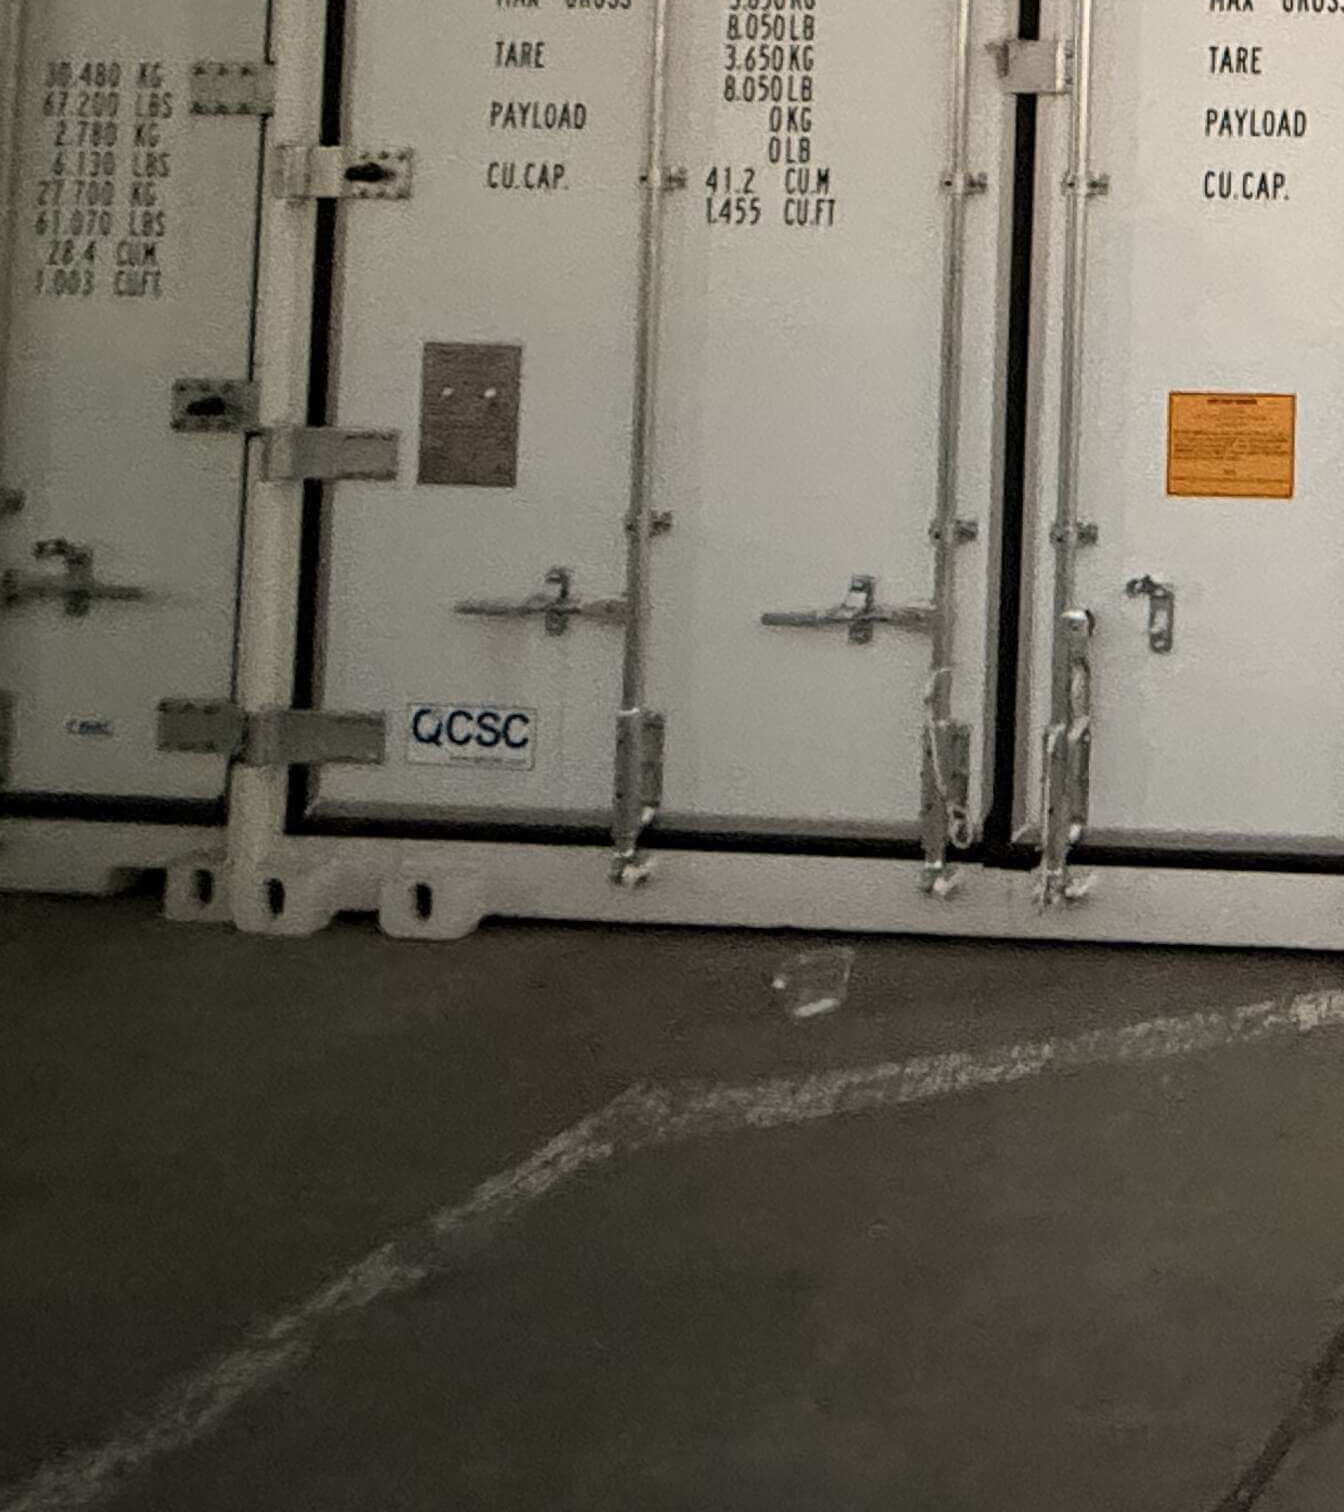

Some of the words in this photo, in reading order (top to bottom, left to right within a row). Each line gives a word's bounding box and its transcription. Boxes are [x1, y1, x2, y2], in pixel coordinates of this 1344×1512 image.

[496, 41, 544, 68] TARE
[1209, 46, 1261, 74] TARE
[490, 101, 586, 130] PAYLOAD
[1205, 109, 1306, 137] PAYLOAD
[1204, 170, 1288, 200] CU.CAP.
[412, 708, 530, 748] QCSC
